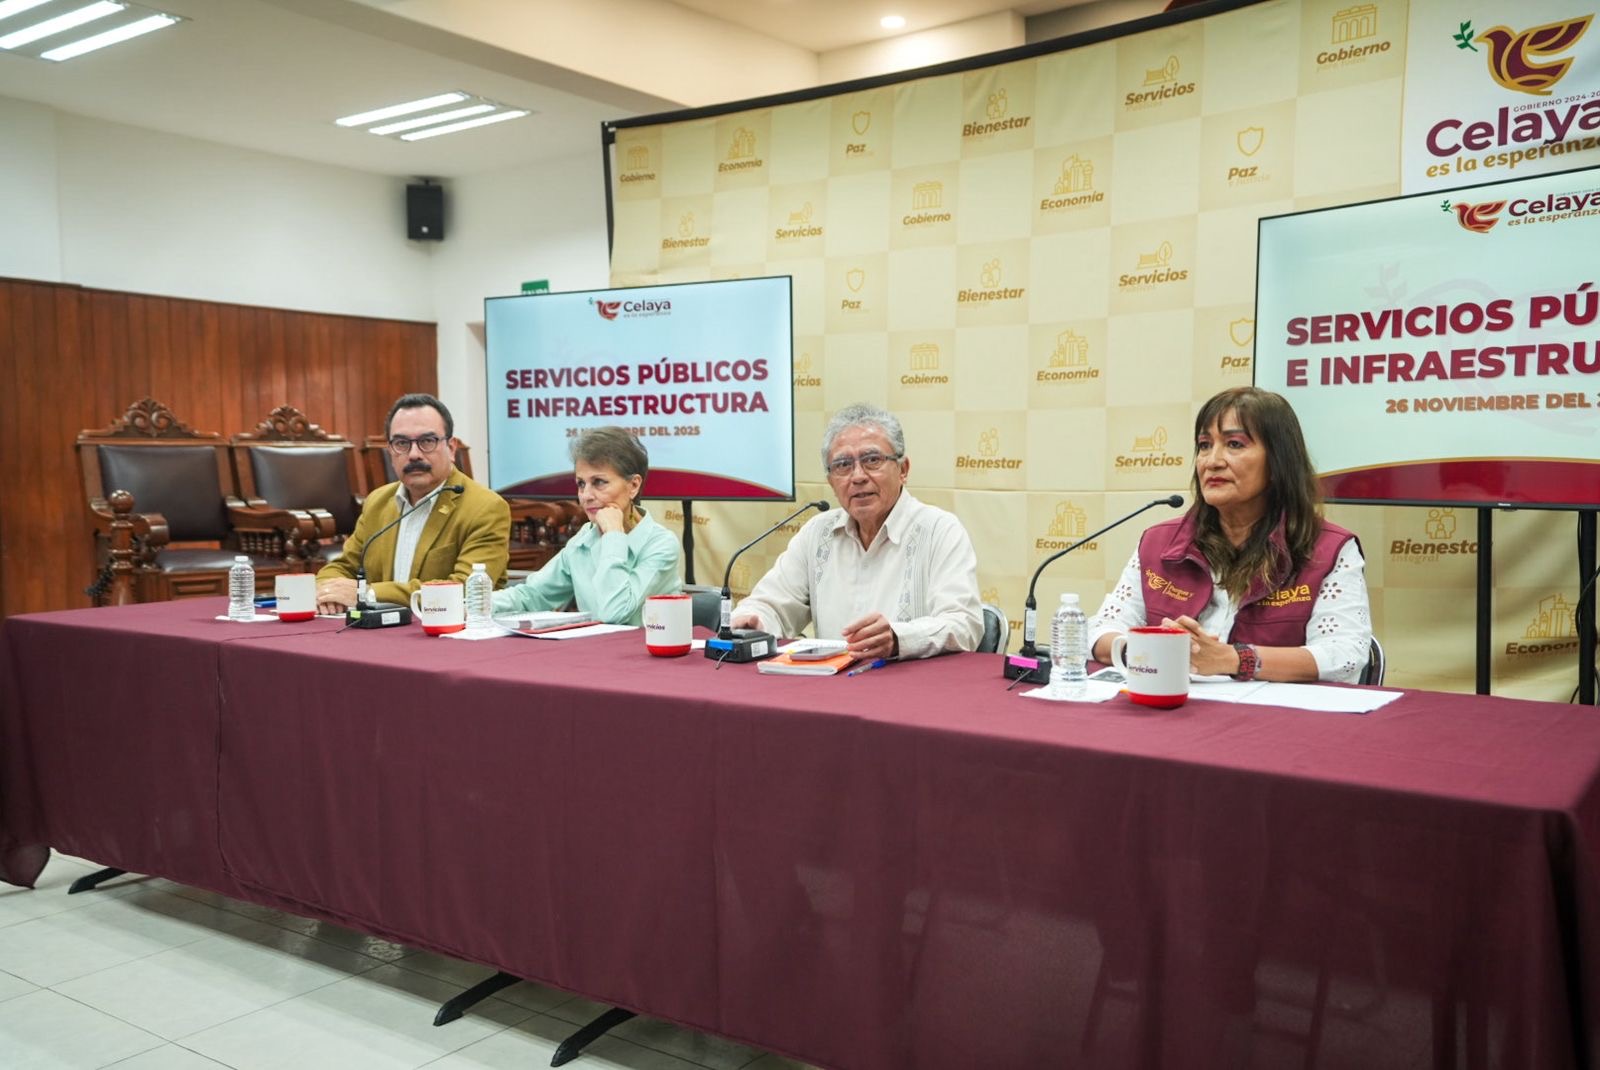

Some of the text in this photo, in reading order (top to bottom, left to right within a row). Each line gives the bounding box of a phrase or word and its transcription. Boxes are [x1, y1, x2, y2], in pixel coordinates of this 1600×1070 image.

[1316, 41, 1391, 65] Gobierno
[1125, 82, 1196, 105] Servicios
[1513, 89, 1600, 112] GOBIERNO 2024-20
[962, 116, 1031, 137] Bienestar
[1426, 99, 1600, 157] Celaya
[846, 143, 866, 155] Paz
[1426, 136, 1600, 178] es la esperanz
[619, 173, 656, 183] Gobierno
[1228, 165, 1258, 181] Paz
[1040, 190, 1105, 210] Economía
[1508, 191, 1600, 217] Celaya
[903, 211, 951, 226] Gobierno
[1508, 208, 1600, 227] es la esperanz
[775, 225, 823, 239] Servicios
[661, 236, 710, 250] Bienestar
[1118, 268, 1188, 288] Servicios
[957, 286, 1025, 303] Bienestar
[623, 299, 671, 313] Celaya
[841, 299, 862, 310] Paz
[1286, 282, 1600, 346] SERVICIOS PÚ
[1221, 356, 1251, 369] Paz
[1286, 341, 1600, 387] E INFRAESTRU
[505, 357, 769, 390] SERVICIOS PÚBLICOS
[901, 373, 949, 385] Gobierno
[1036, 366, 1100, 382] Economía
[507, 391, 769, 419] E INFRAESTRUCTURA
[1386, 398, 1409, 414] 26
[1413, 394, 1540, 413] NOVIEMBRE
[1546, 392, 1592, 409] DEL
[649, 426, 672, 437] DEL
[674, 426, 700, 437] 2025
[955, 455, 1023, 470] Bienestar
[1114, 453, 1184, 468] Servicios
[1390, 538, 1493, 555] Bienesta
